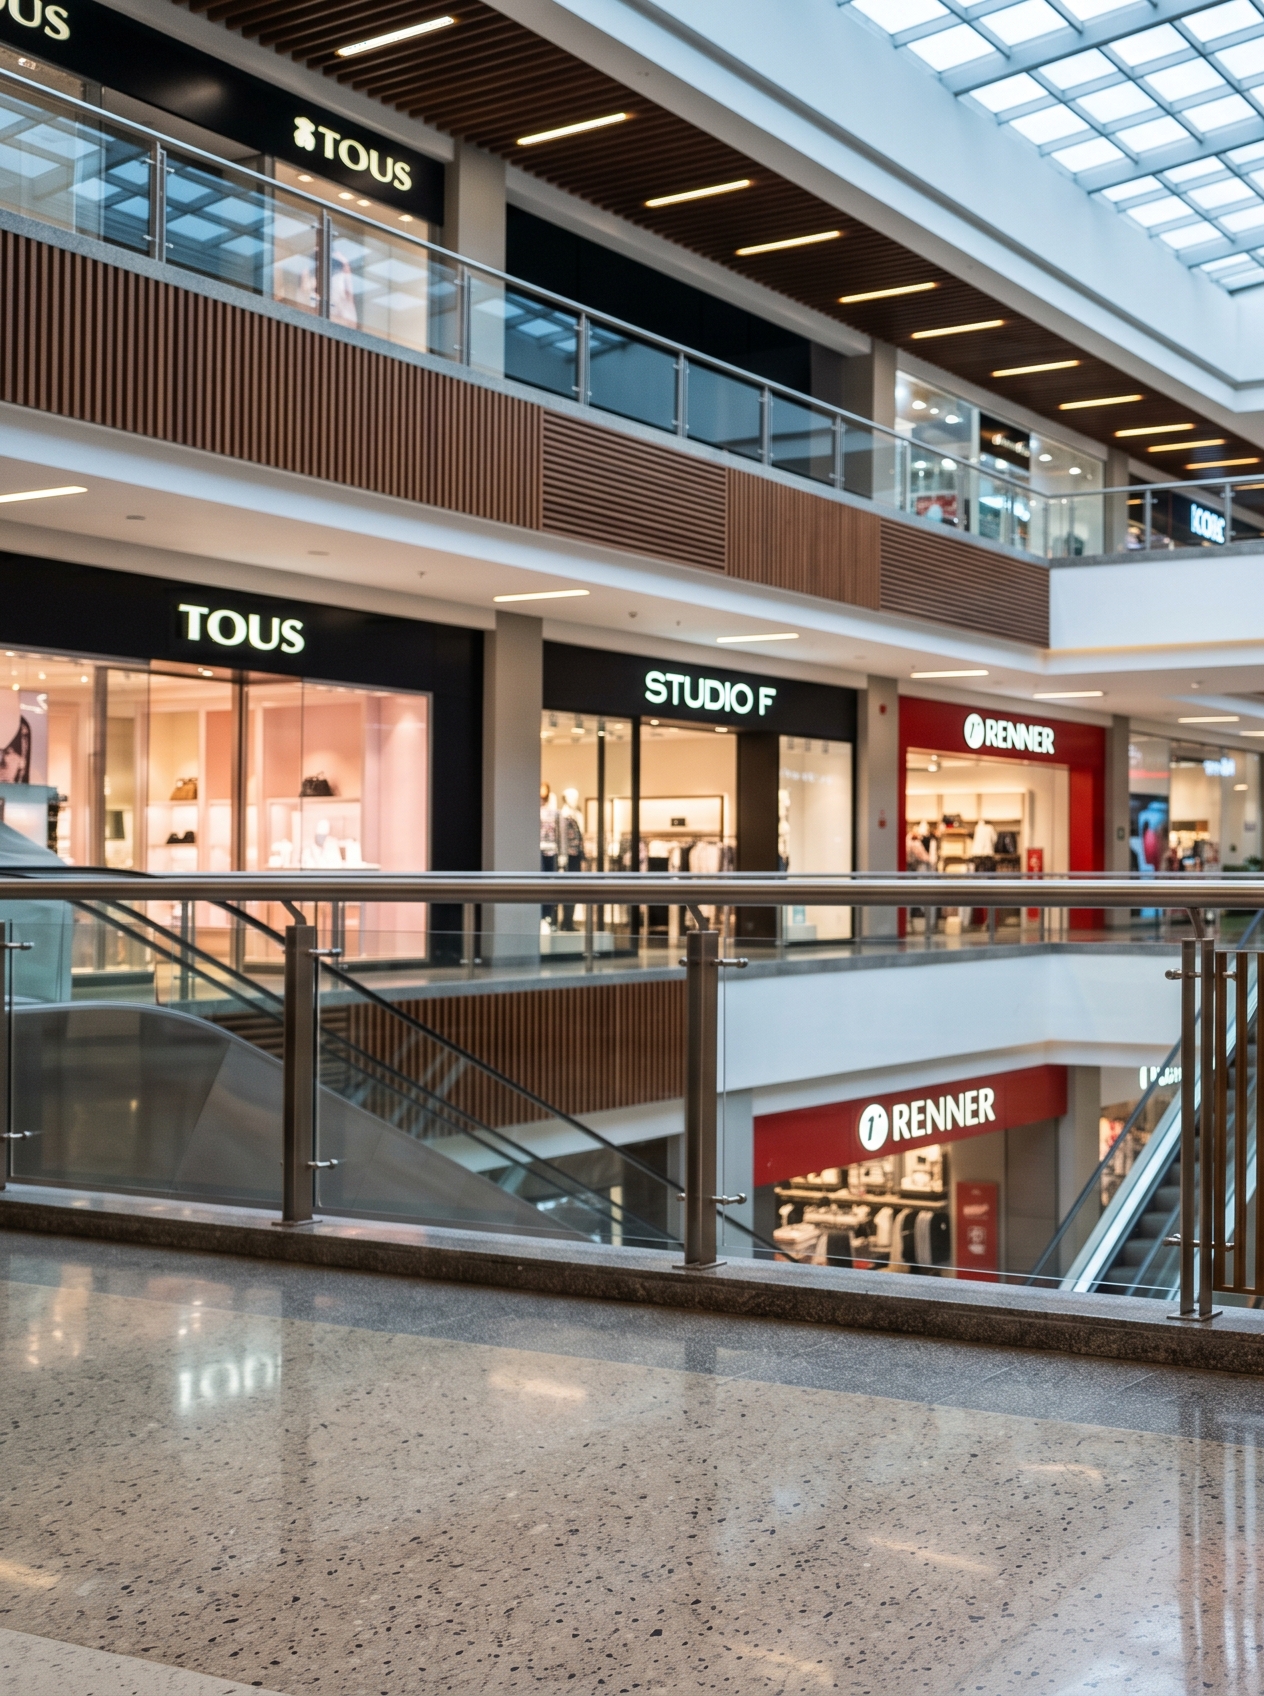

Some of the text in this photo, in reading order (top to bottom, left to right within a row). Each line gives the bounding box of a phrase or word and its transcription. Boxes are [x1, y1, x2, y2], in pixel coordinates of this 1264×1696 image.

[318, 125, 412, 191] TOUS
[178, 603, 305, 654] TOUS
[645, 670, 777, 716] STUDIO F
[985, 718, 1055, 755] RENNER
[892, 1087, 996, 1142] RENNER
